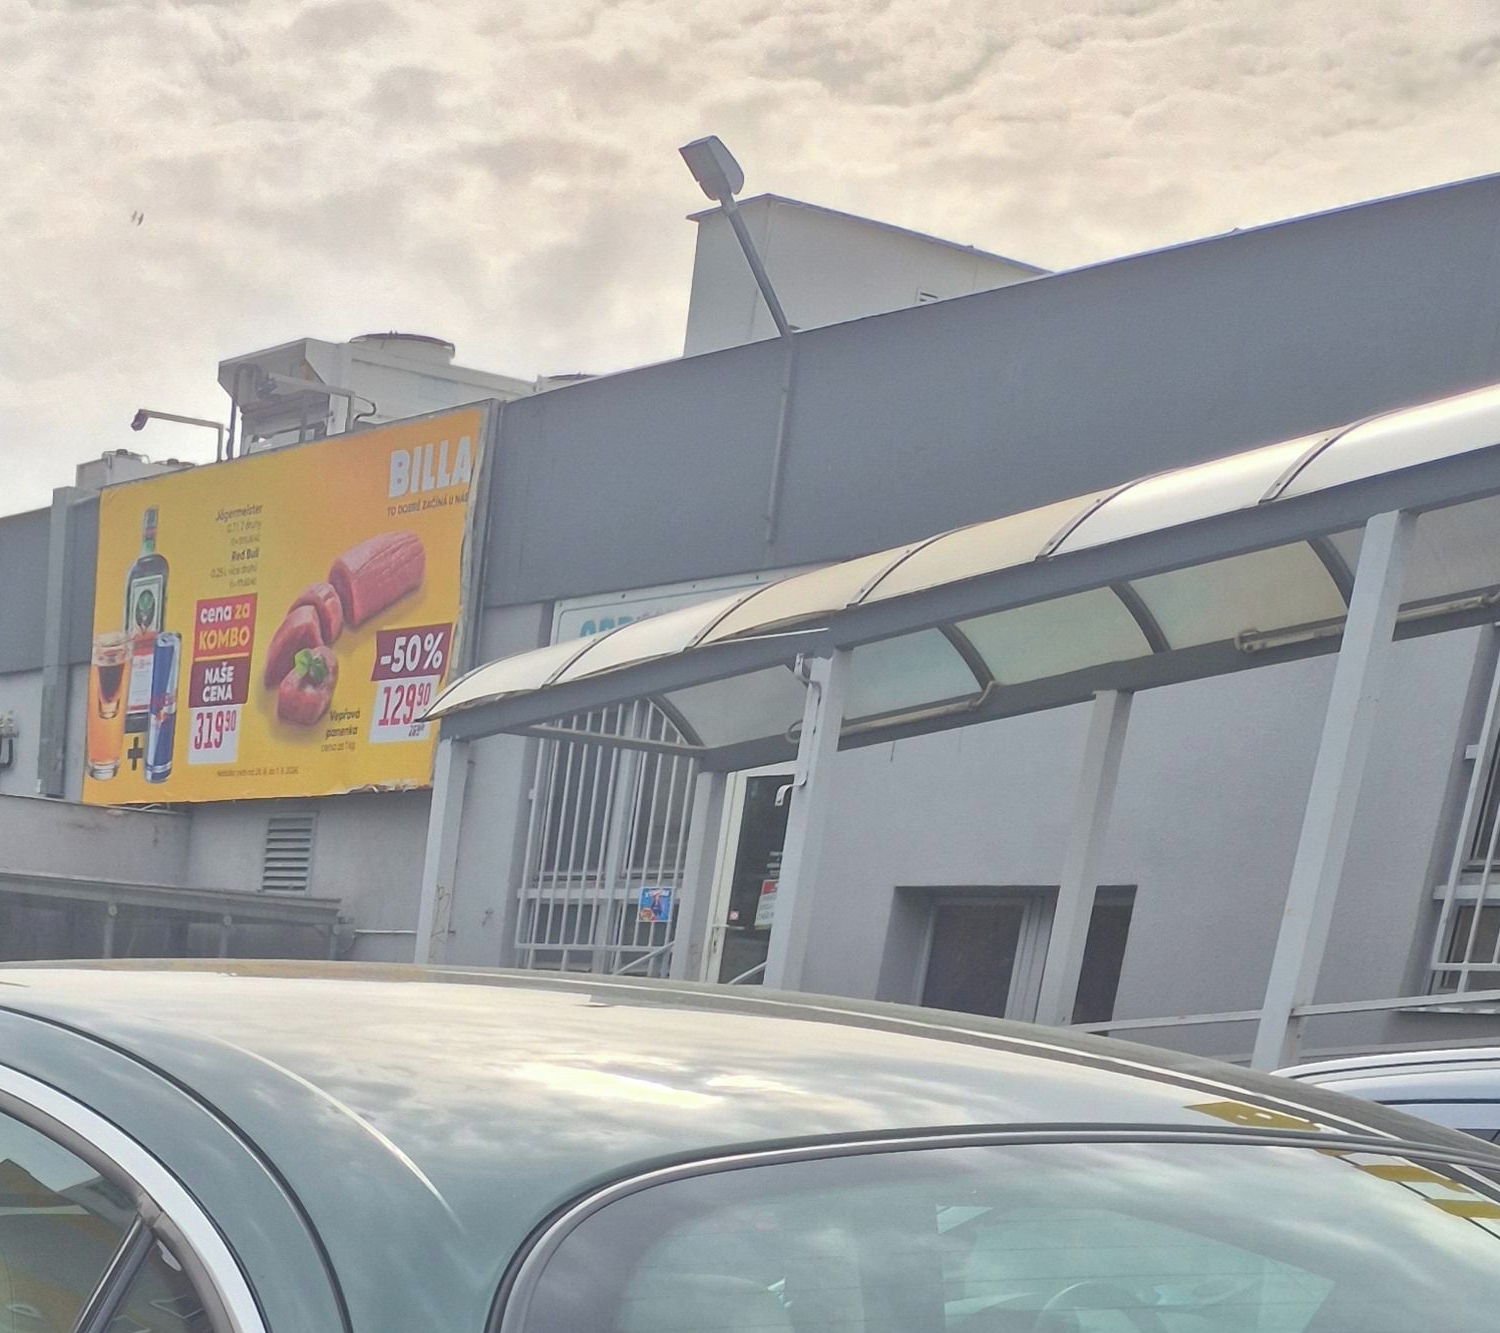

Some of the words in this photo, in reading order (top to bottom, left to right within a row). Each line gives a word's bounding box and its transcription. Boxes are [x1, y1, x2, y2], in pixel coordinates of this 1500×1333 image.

[389, 437, 470, 498] BILLA
[231, 551, 245, 561] Red
[247, 548, 259, 559] Bull
[200, 605, 232, 624] cena
[235, 603, 250, 619] za
[199, 625, 250, 650] KOMBO
[380, 632, 444, 673] -50%
[204, 661, 234, 684] NAŠE
[202, 684, 232, 703] CENA
[325, 725, 358, 740] panenka
